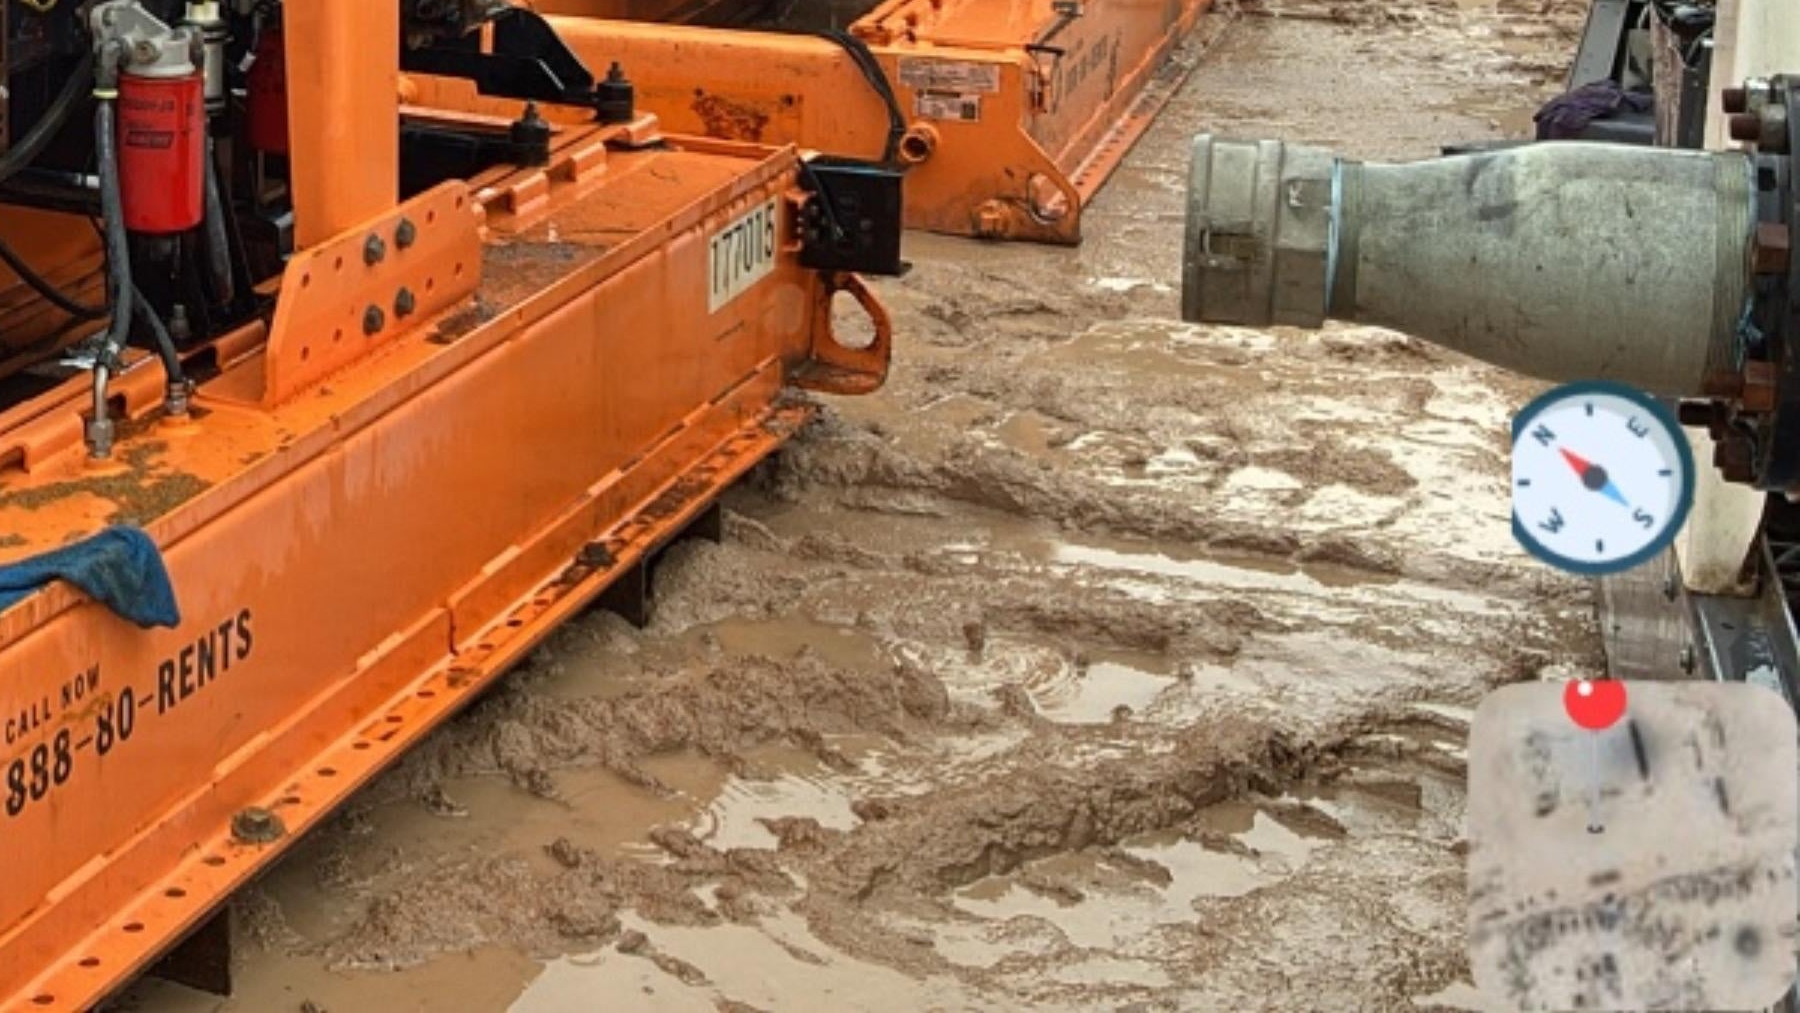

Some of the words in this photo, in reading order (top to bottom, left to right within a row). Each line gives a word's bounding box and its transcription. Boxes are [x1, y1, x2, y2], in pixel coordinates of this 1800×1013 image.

[5, 696, 52, 745] CALL
[61, 662, 100, 708] NOW
[5, 607, 253, 817] 888-80-RENTS
